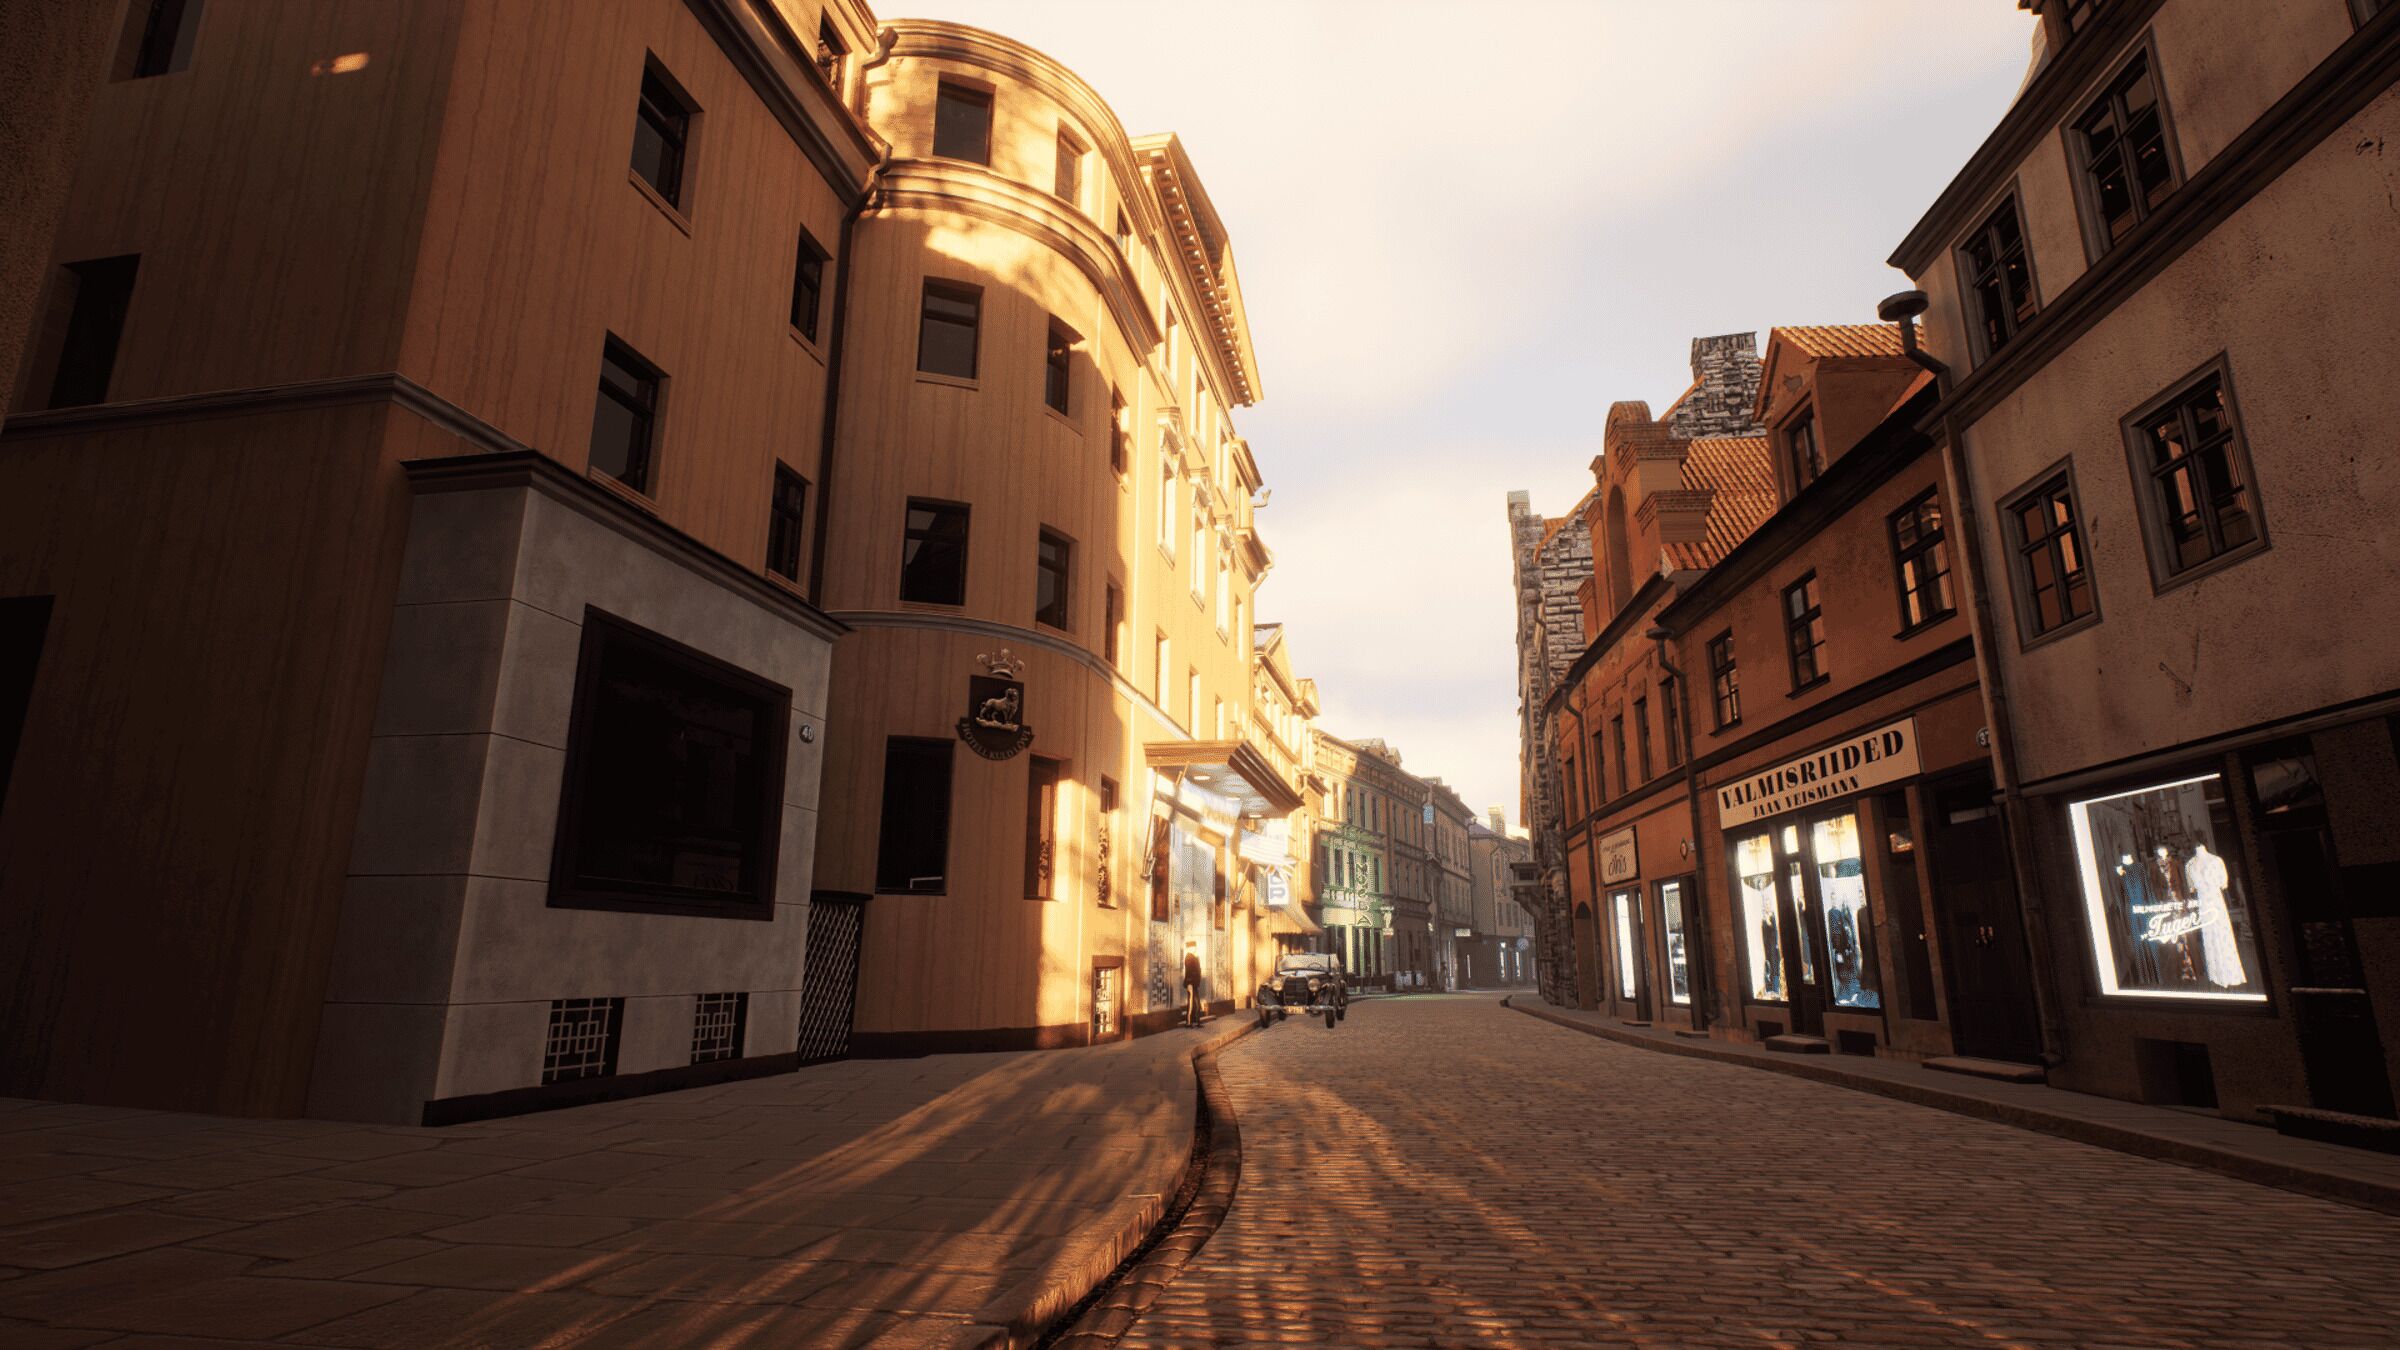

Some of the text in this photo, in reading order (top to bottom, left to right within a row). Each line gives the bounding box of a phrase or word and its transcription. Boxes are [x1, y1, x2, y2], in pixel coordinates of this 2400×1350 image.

[802, 726, 814, 740] 40
[961, 723, 989, 756] HOTELL
[1721, 730, 1904, 810] VALMISRIIDED
[1753, 775, 1860, 818] JAAN VEISMANN
